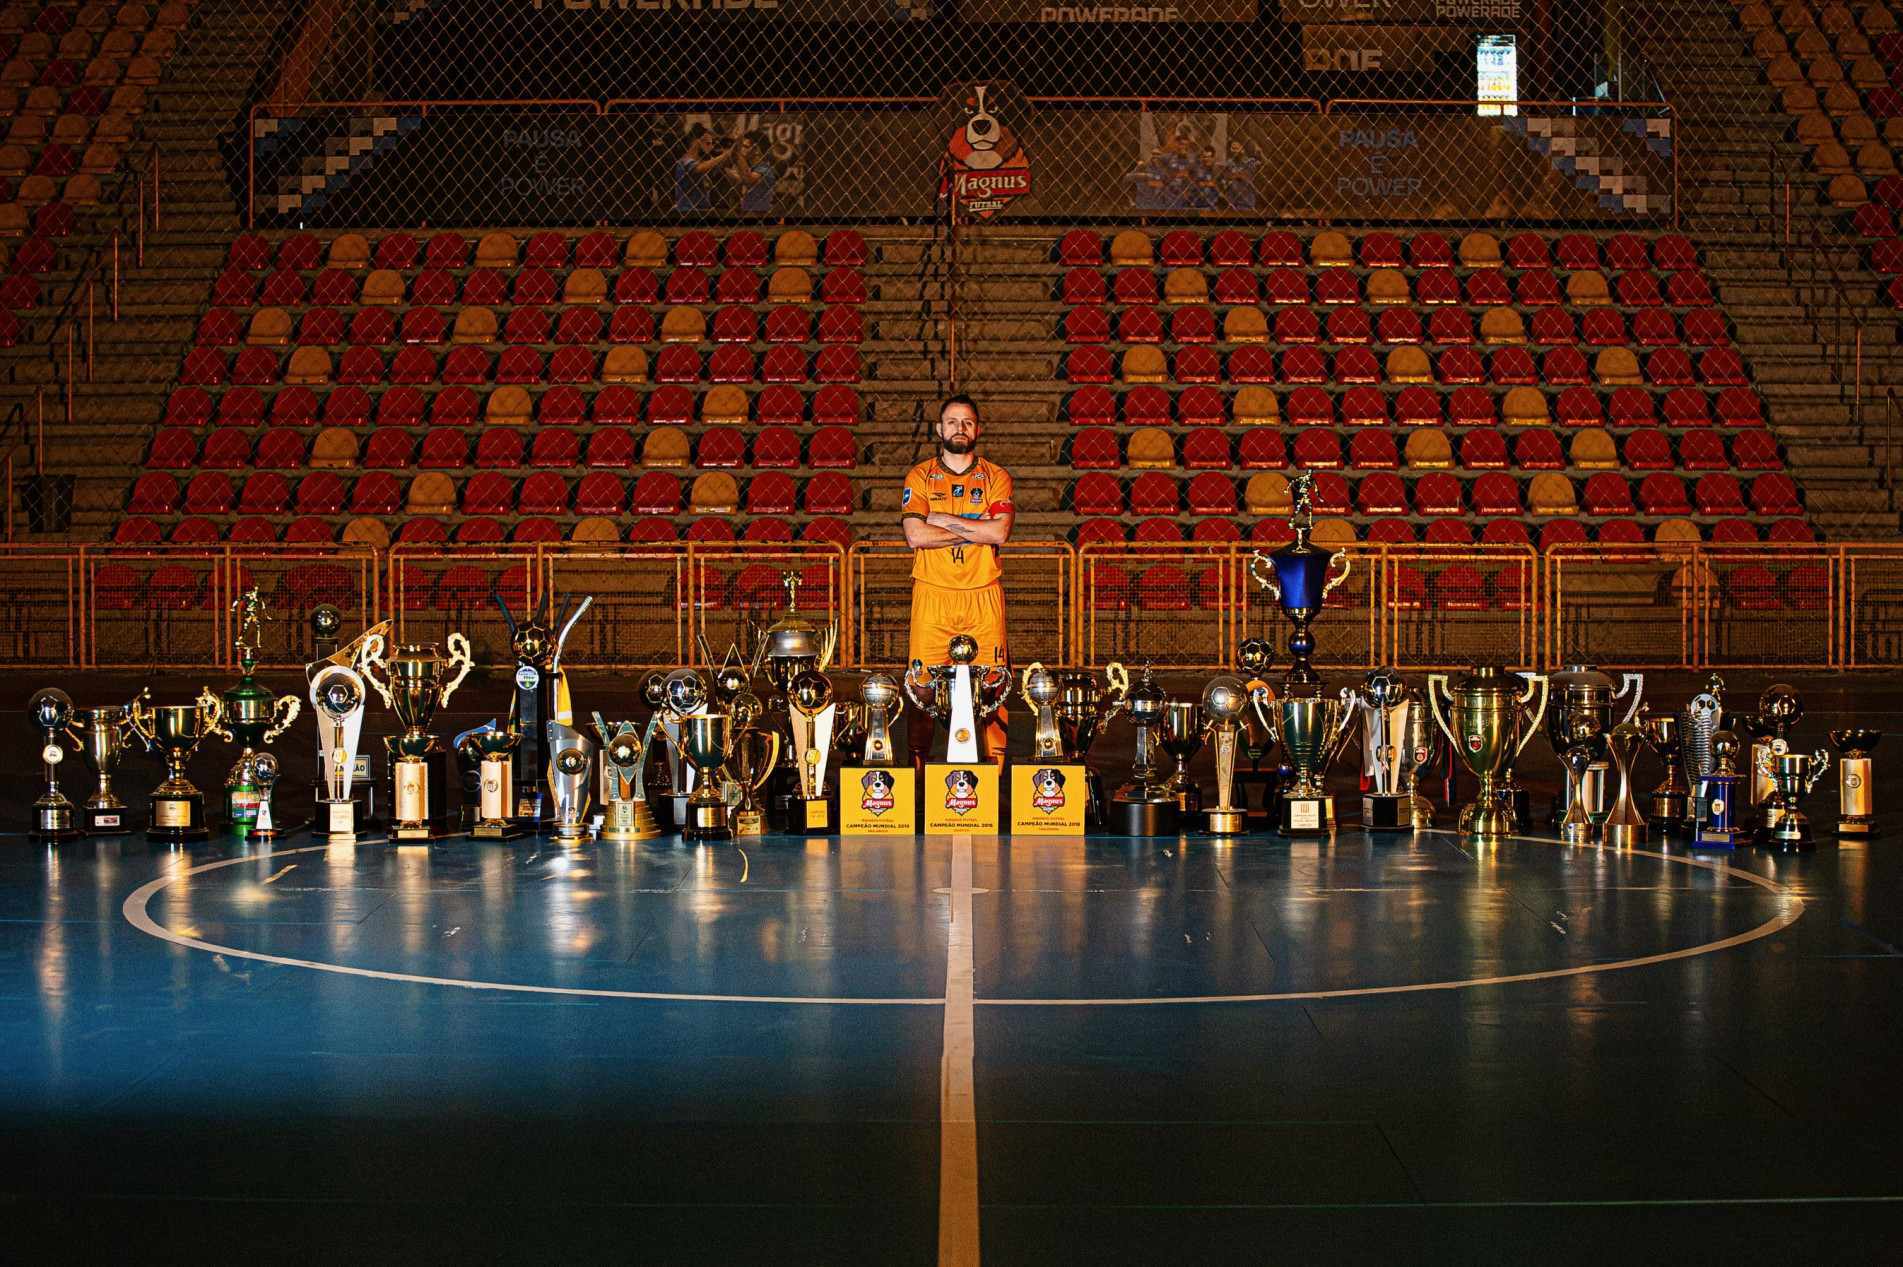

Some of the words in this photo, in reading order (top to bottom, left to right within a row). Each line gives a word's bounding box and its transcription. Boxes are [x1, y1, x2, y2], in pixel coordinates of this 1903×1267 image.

[1436, 6, 1520, 18] POWERADE
[503, 129, 583, 150] PAUSA
[1338, 128, 1418, 150] PAUSA
[501, 177, 586, 196] POWER
[954, 174, 1027, 198] Magnus
[1337, 177, 1422, 196] POWER
[951, 547, 964, 564] 14
[994, 644, 1005, 663] 14
